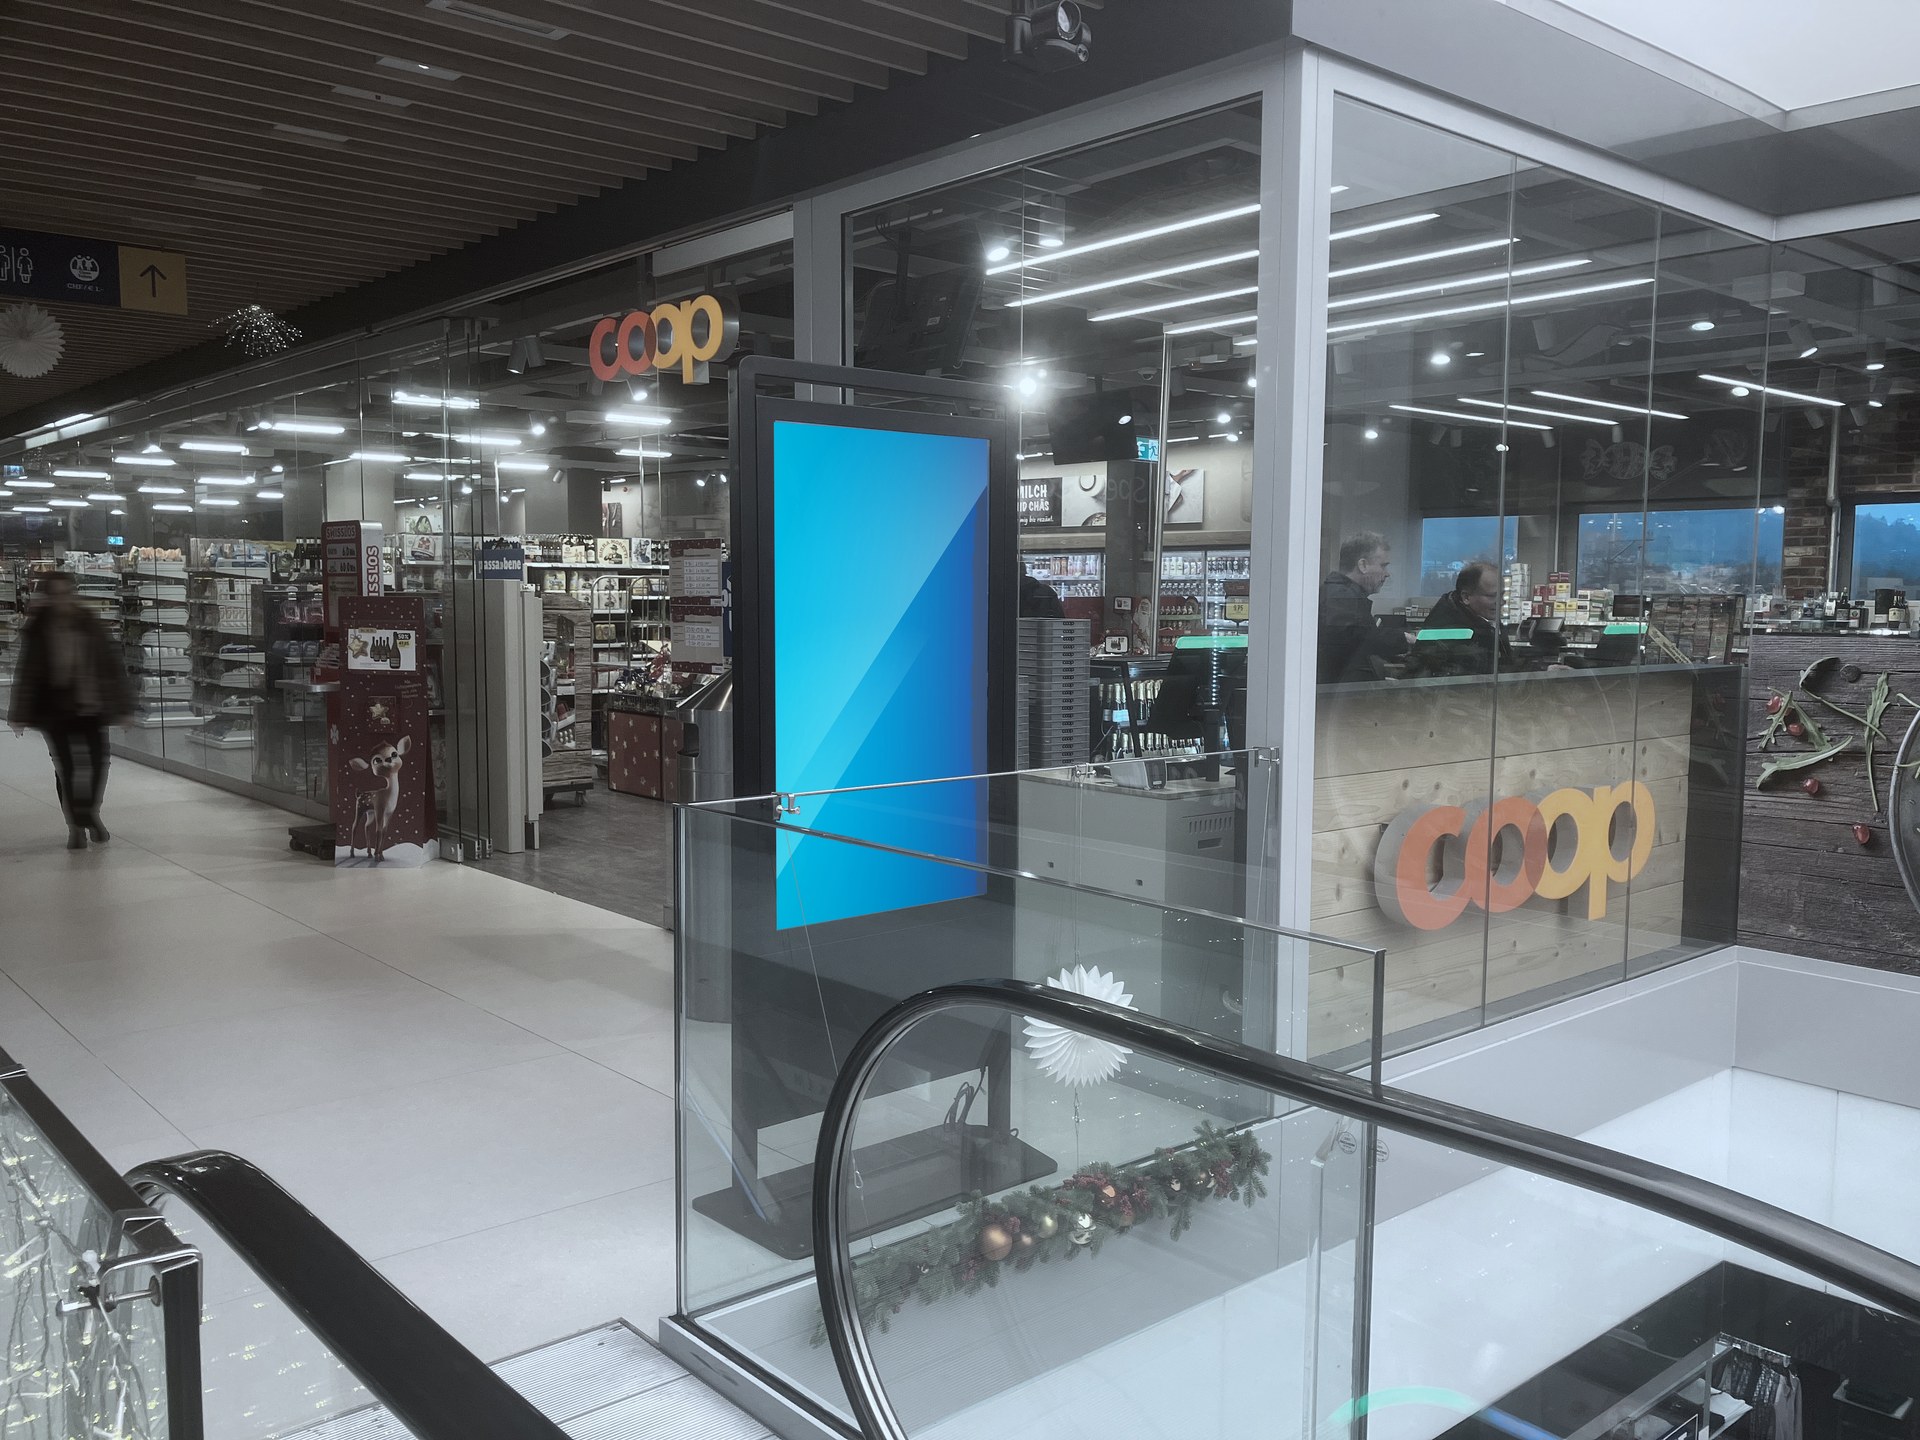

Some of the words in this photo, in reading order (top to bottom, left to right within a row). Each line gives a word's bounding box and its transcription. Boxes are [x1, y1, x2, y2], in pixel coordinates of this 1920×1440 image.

[589, 295, 723, 384] coop
[1028, 499, 1050, 512] CHÄS
[326, 526, 356, 540] SWISSLOS
[366, 546, 380, 596] ISSLOS
[1396, 780, 1656, 921] coop
